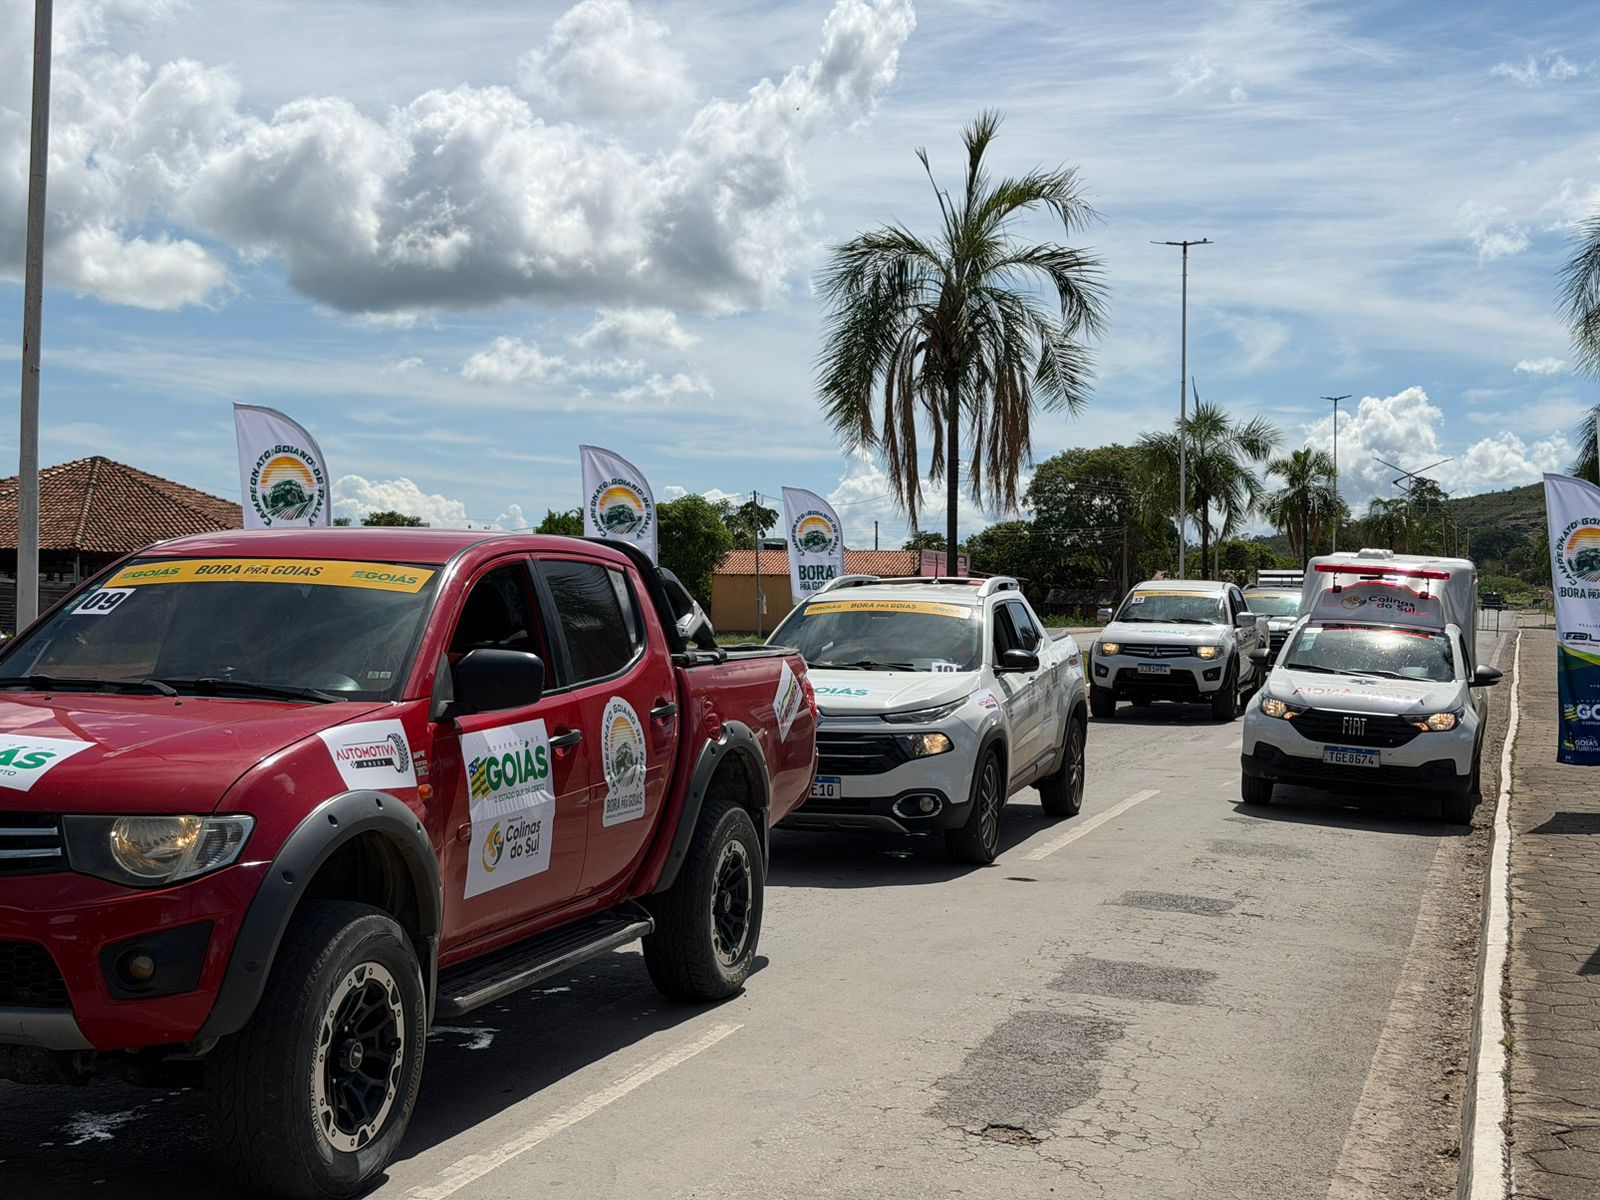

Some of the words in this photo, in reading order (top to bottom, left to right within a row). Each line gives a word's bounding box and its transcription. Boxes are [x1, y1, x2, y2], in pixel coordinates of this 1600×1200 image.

[274, 445, 314, 466] GOIANO
[313, 467, 324, 484] DE
[250, 449, 272, 527] CAMPEONATO
[611, 478, 643, 496] GOIANO
[308, 488, 325, 527] RALLY
[590, 481, 608, 537] CAMPEONATO
[642, 496, 652, 509] DE
[636, 512, 652, 539] RALLY
[791, 513, 806, 557] CAMPEONATO
[1556, 520, 1578, 586] CAMPEONATO
[194, 564, 242, 575] BORA
[798, 564, 834, 580] BORA
[80, 592, 127, 611] 09
[1368, 595, 1415, 607] Colinas
[1560, 586, 1587, 599] BORA
[1397, 604, 1416, 613] Sul
[1342, 716, 1368, 737] FIAT
[336, 744, 397, 761] AUTOMOTIVA
[603, 711, 619, 796] CAMPEONATO
[612, 703, 636, 725] GOIANO
[485, 740, 549, 791] GOIÁS
[506, 820, 541, 842] Colinas
[510, 840, 523, 859] do
[525, 833, 540, 854] Sul
